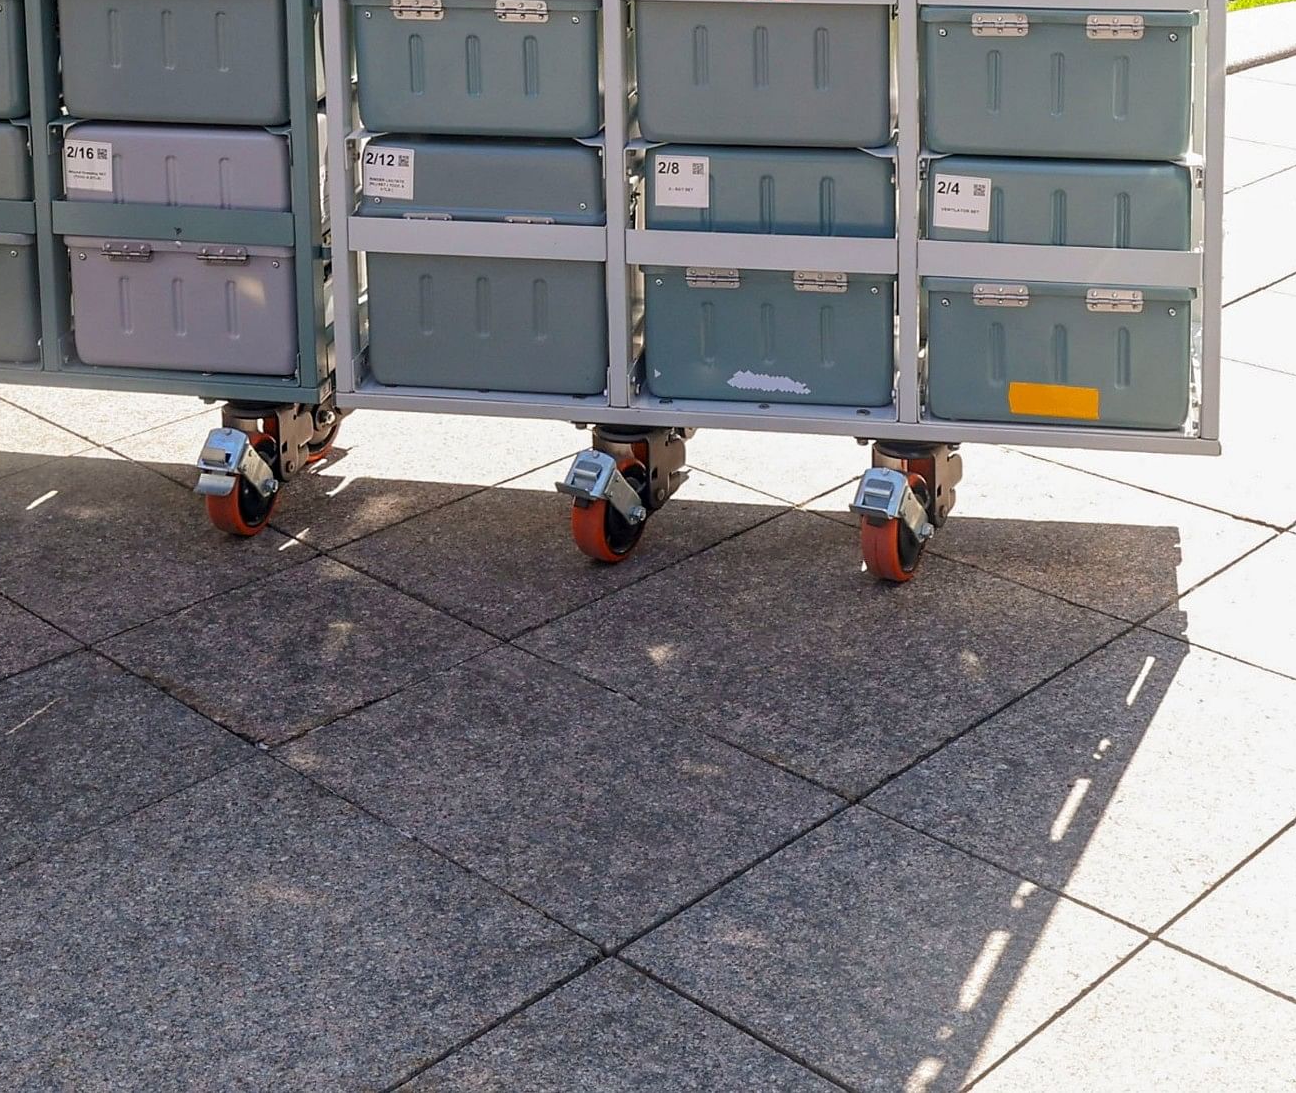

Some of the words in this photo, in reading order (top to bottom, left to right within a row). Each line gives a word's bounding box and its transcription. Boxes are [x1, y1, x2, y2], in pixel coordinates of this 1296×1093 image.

[67, 146, 94, 159] 2/16
[366, 152, 395, 166] 2/12
[658, 161, 679, 174] 2/8
[937, 181, 960, 195] 2/4
